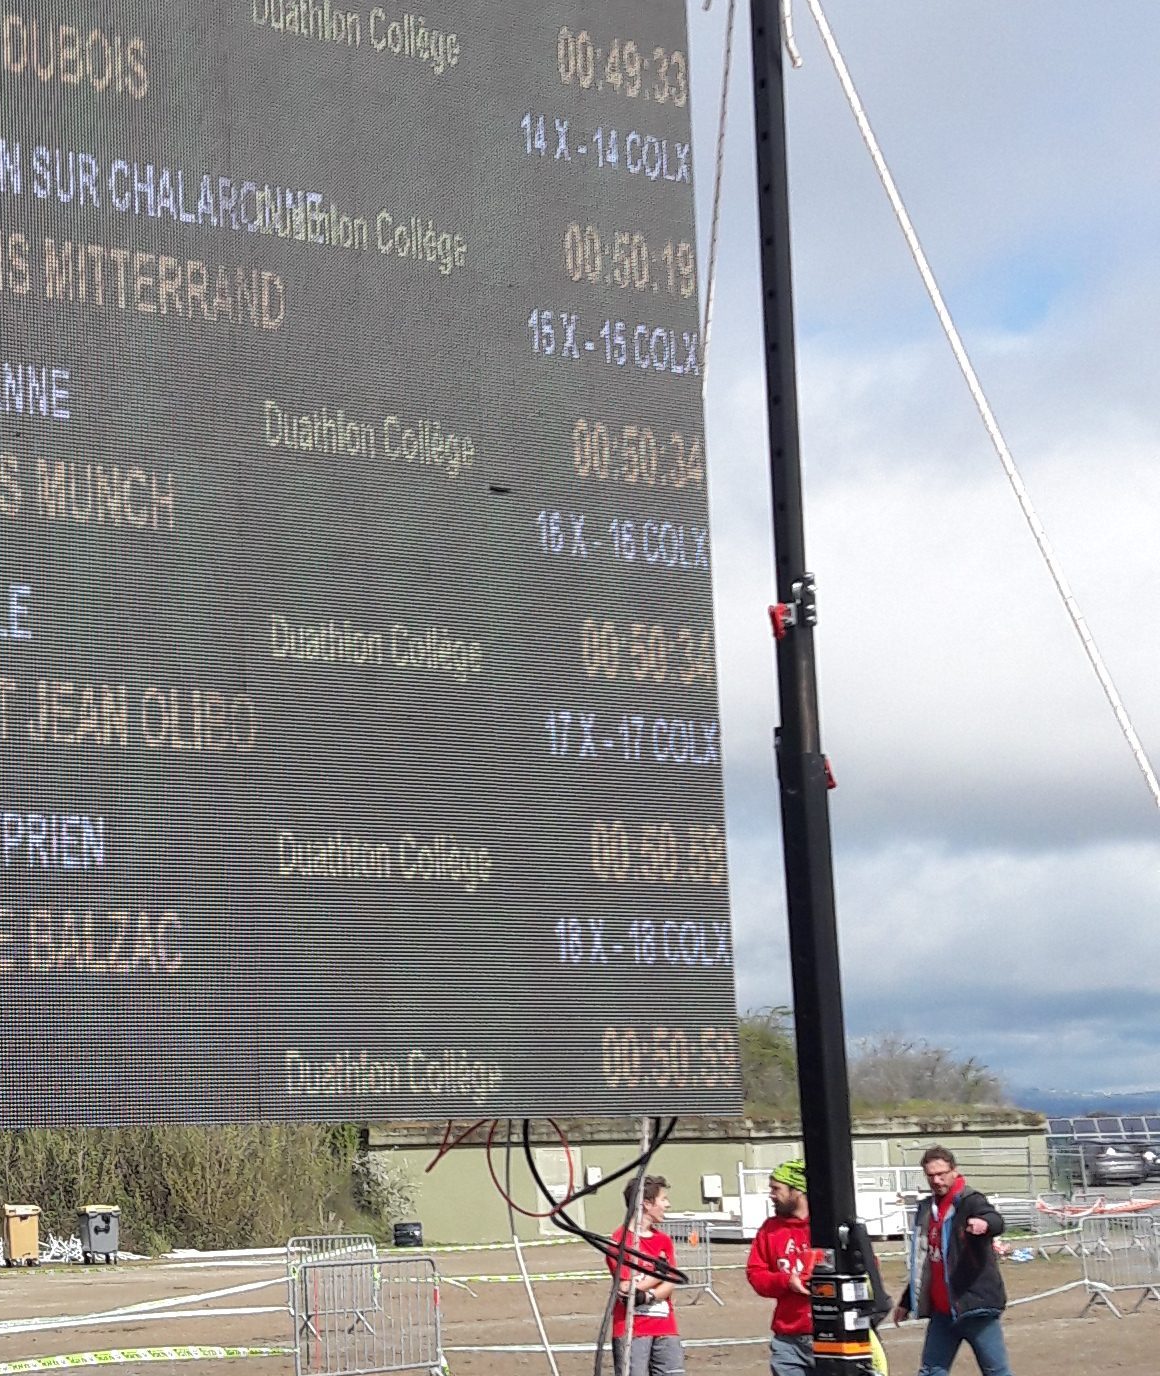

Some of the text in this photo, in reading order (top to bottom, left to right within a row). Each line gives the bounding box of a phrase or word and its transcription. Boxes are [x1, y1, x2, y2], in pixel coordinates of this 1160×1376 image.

[4, 17, 148, 99] DUBOIS
[557, 25, 687, 107] 00:49:33
[33, 146, 102, 211] SUR
[521, 111, 547, 156] 14
[554, 118, 572, 161] X
[593, 126, 619, 169] 14
[626, 130, 690, 183] COLX
[45, 237, 286, 330] MITTERRAND
[528, 308, 555, 355] 15
[560, 313, 580, 359] X
[600, 319, 626, 365] 15
[634, 325, 699, 375] COLX
[265, 401, 376, 458] Duathlon
[39, 456, 178, 528] MUNCH
[537, 510, 564, 554] 16
[608, 519, 636, 562] 16
[643, 520, 709, 571] COLX
[271, 615, 383, 665] Duathlon
[27, 677, 129, 746] JEAN
[140, 687, 258, 752] OLIBO
[544, 712, 572, 756] 17
[617, 717, 644, 760] 17
[653, 719, 717, 763] COLX
[278, 832, 392, 880] Duathlon
[29, 911, 183, 975] BALZAC
[554, 918, 582, 963] 18
[628, 921, 656, 964] 18
[663, 921, 731, 965] COLX
[286, 1050, 399, 1096] Duathlon
